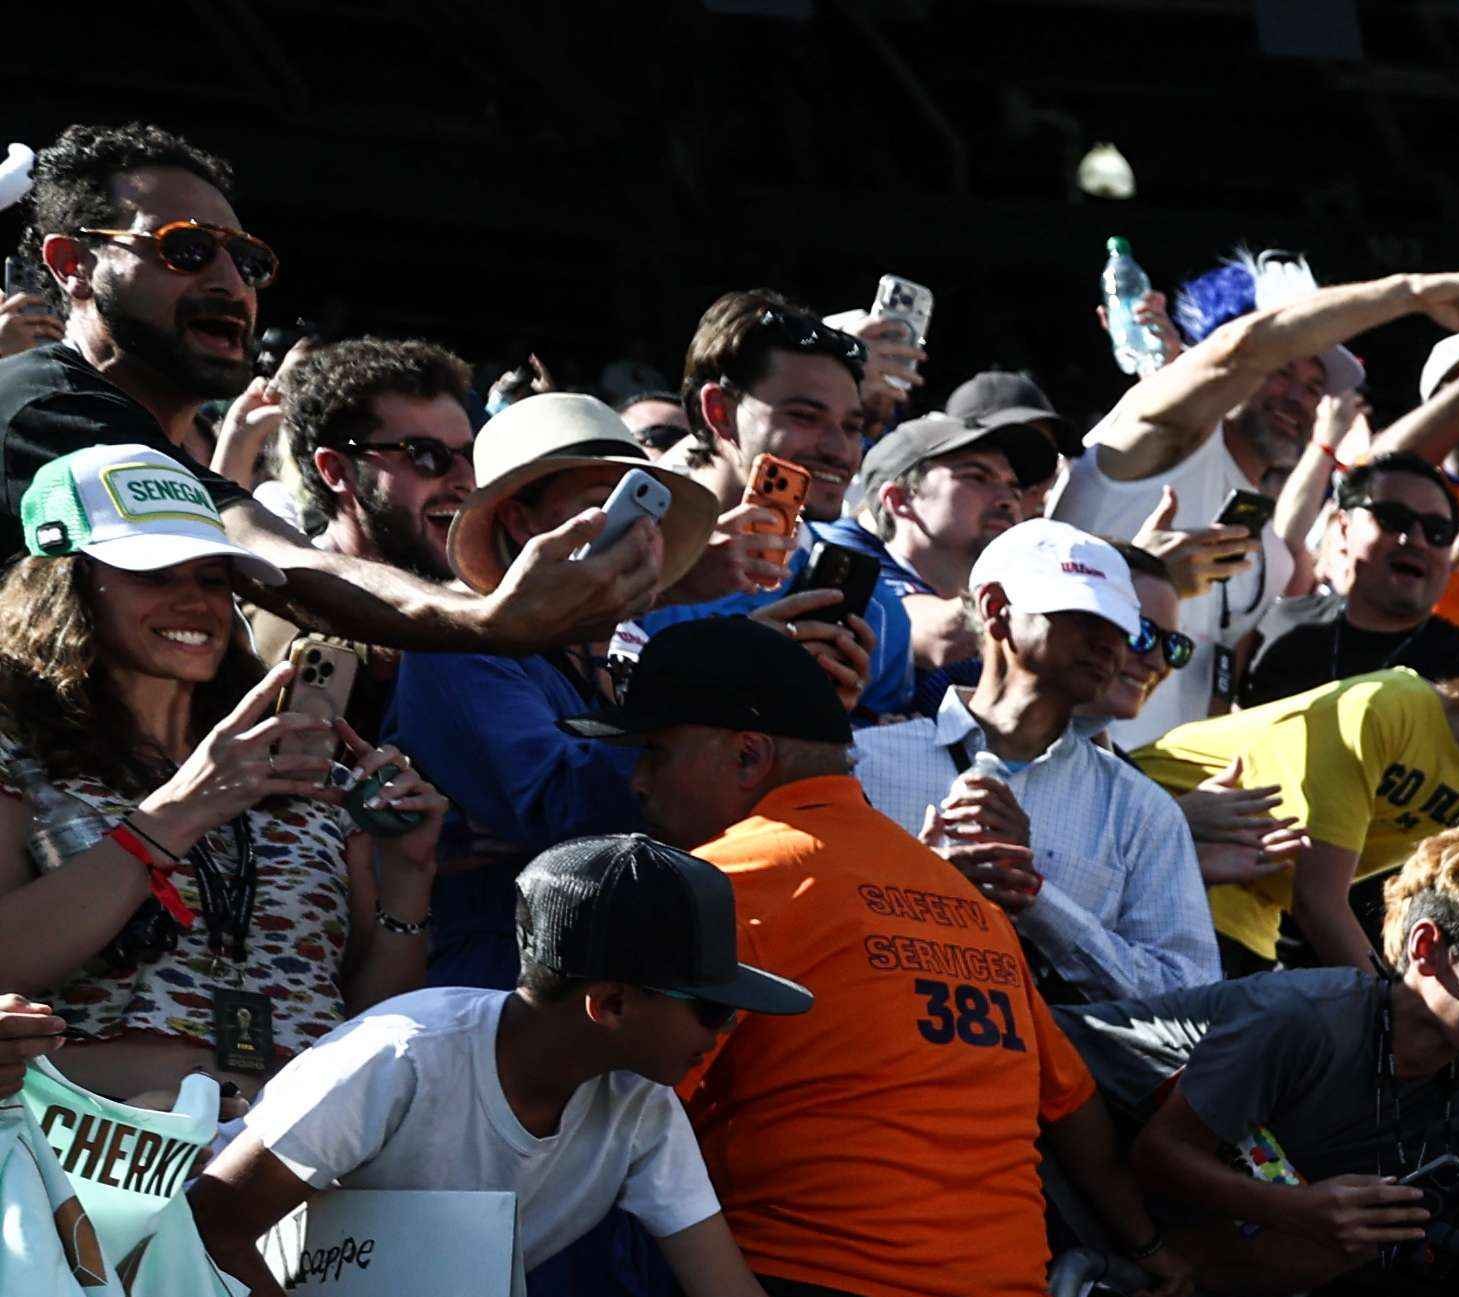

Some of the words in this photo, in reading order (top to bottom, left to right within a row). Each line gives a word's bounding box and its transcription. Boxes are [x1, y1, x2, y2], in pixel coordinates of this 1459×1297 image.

[858, 885, 989, 932] SAFETY
[866, 936, 1021, 987] SERVICES
[915, 979, 1027, 1053] 381
[39, 1104, 199, 1199] CHERKI
